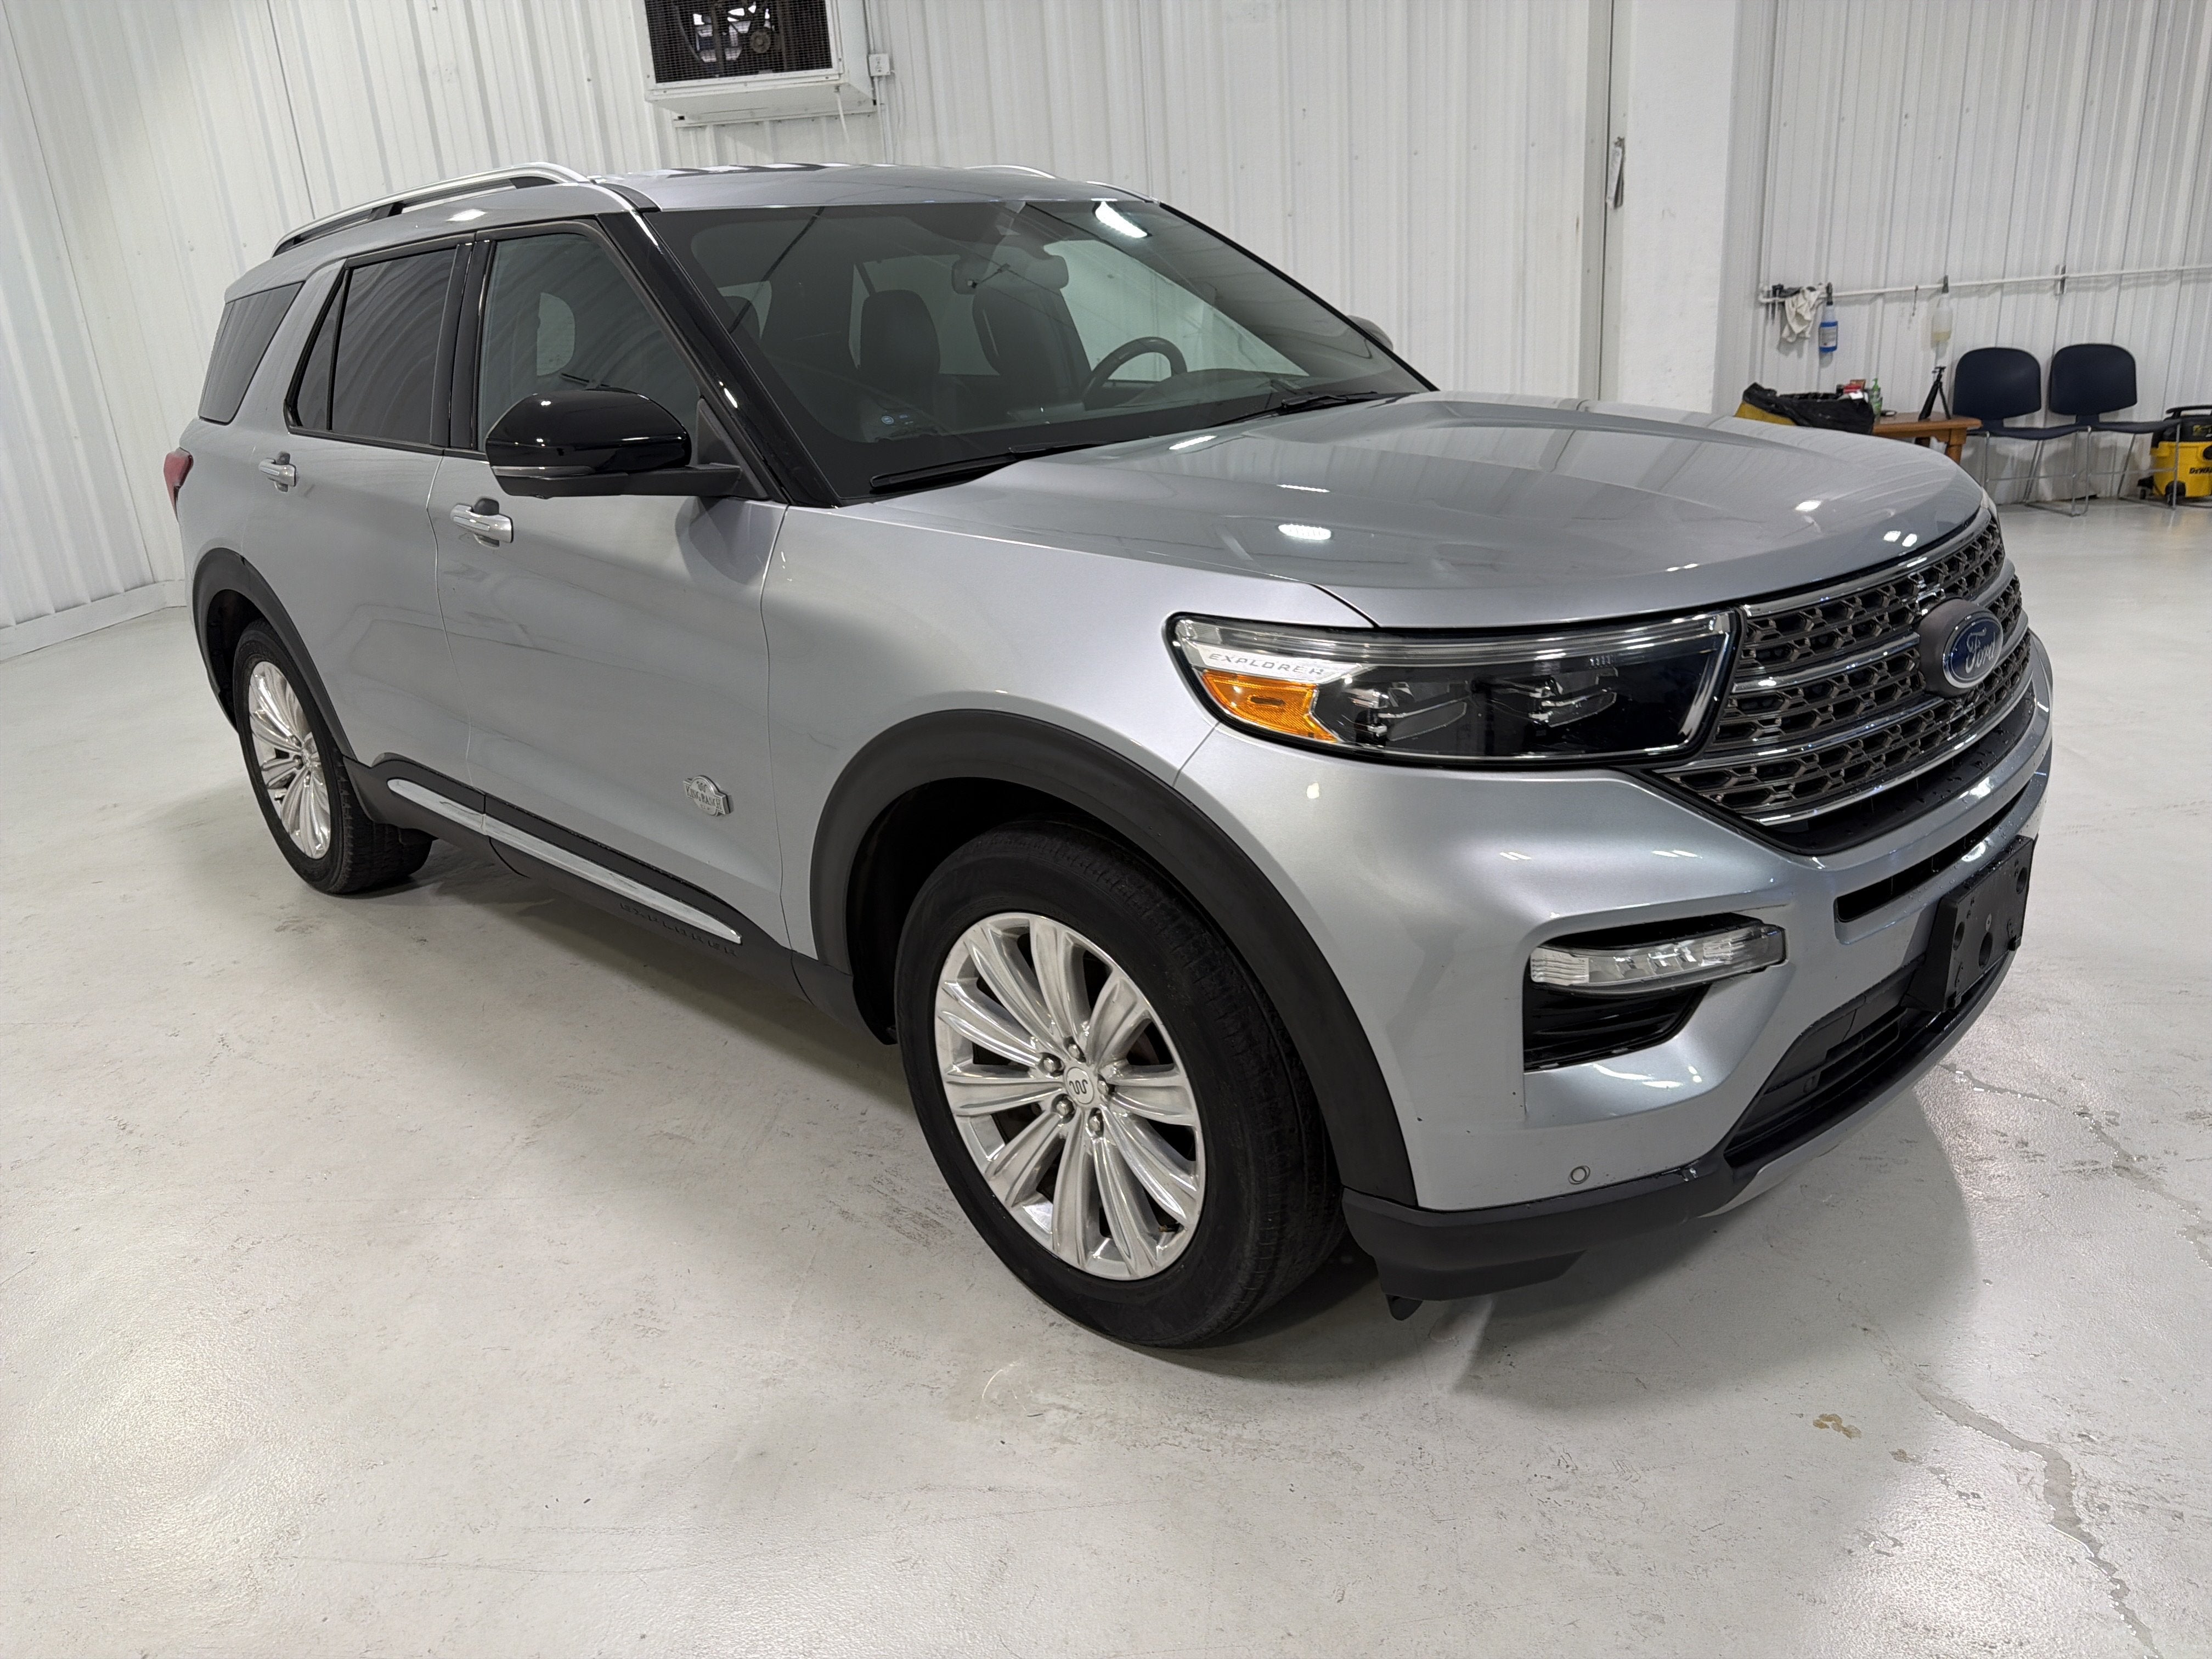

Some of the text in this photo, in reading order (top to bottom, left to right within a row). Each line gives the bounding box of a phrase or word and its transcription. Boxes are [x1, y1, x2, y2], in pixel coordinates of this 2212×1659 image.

[1966, 627, 1996, 674] Ford
[1208, 653, 1324, 675] EXPLORER
[685, 785, 701, 802] KING
[701, 793, 723, 811] RANCH
